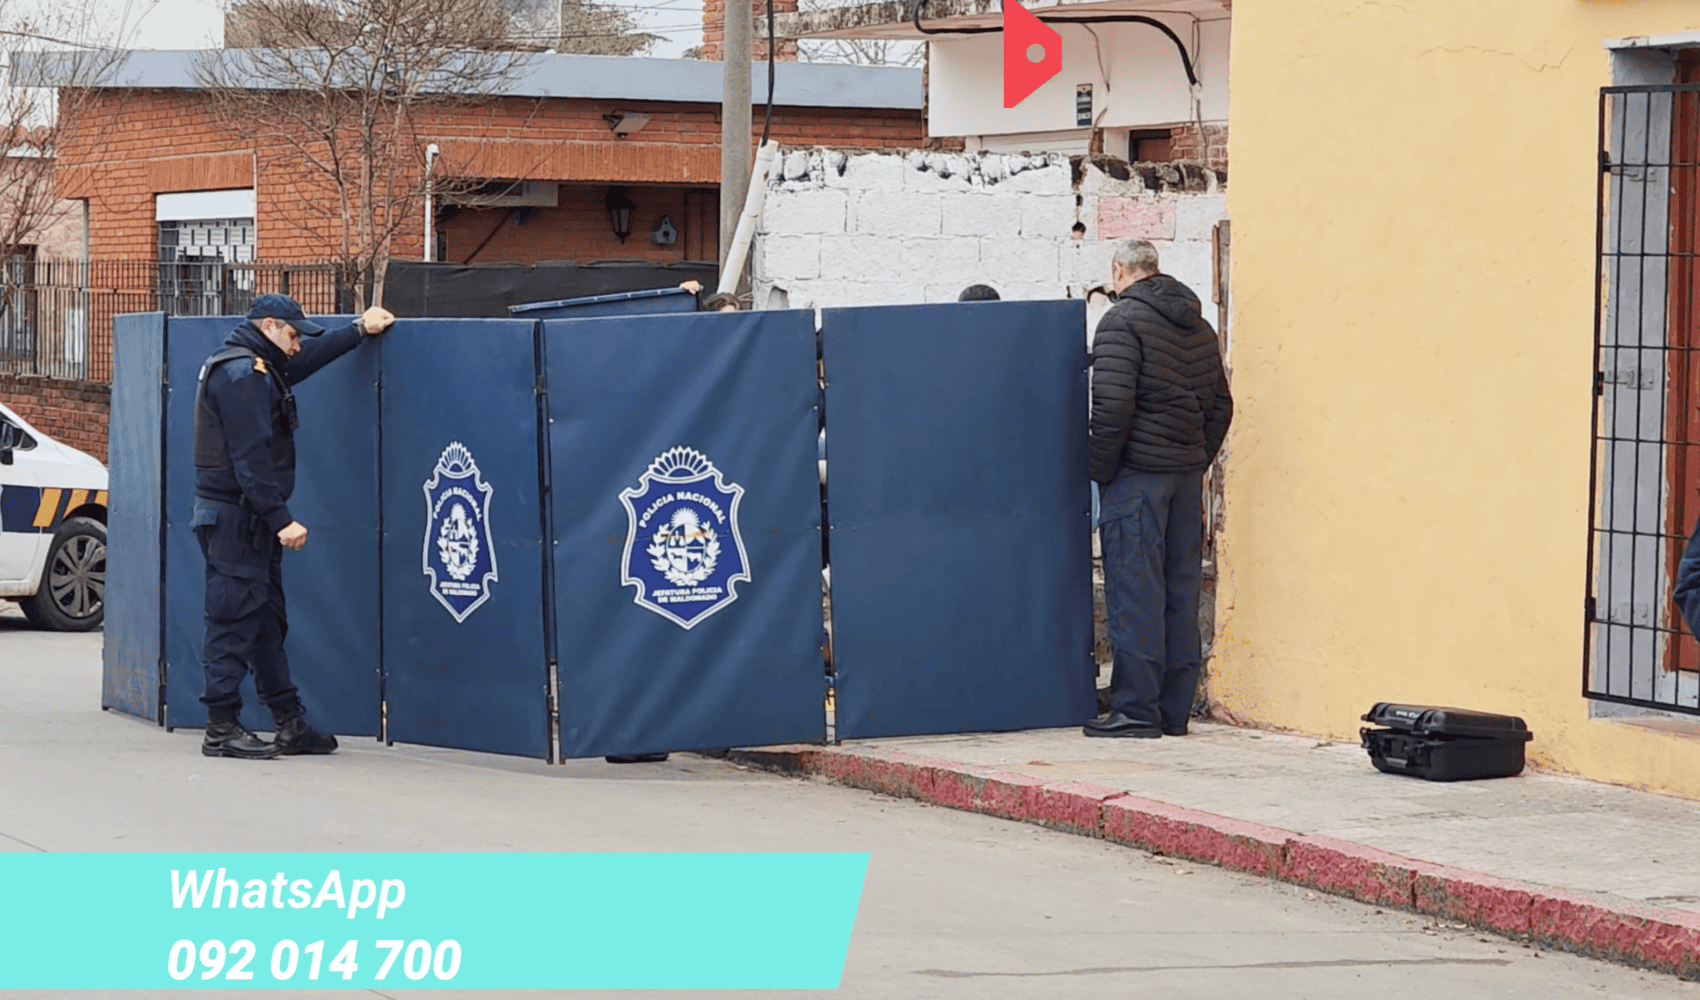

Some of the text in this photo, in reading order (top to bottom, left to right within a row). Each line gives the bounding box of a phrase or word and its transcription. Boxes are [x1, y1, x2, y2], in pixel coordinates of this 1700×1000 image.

[433, 486, 482, 522] POLICIA NACIONAL
[639, 491, 726, 528] POLICIA NACIONAL
